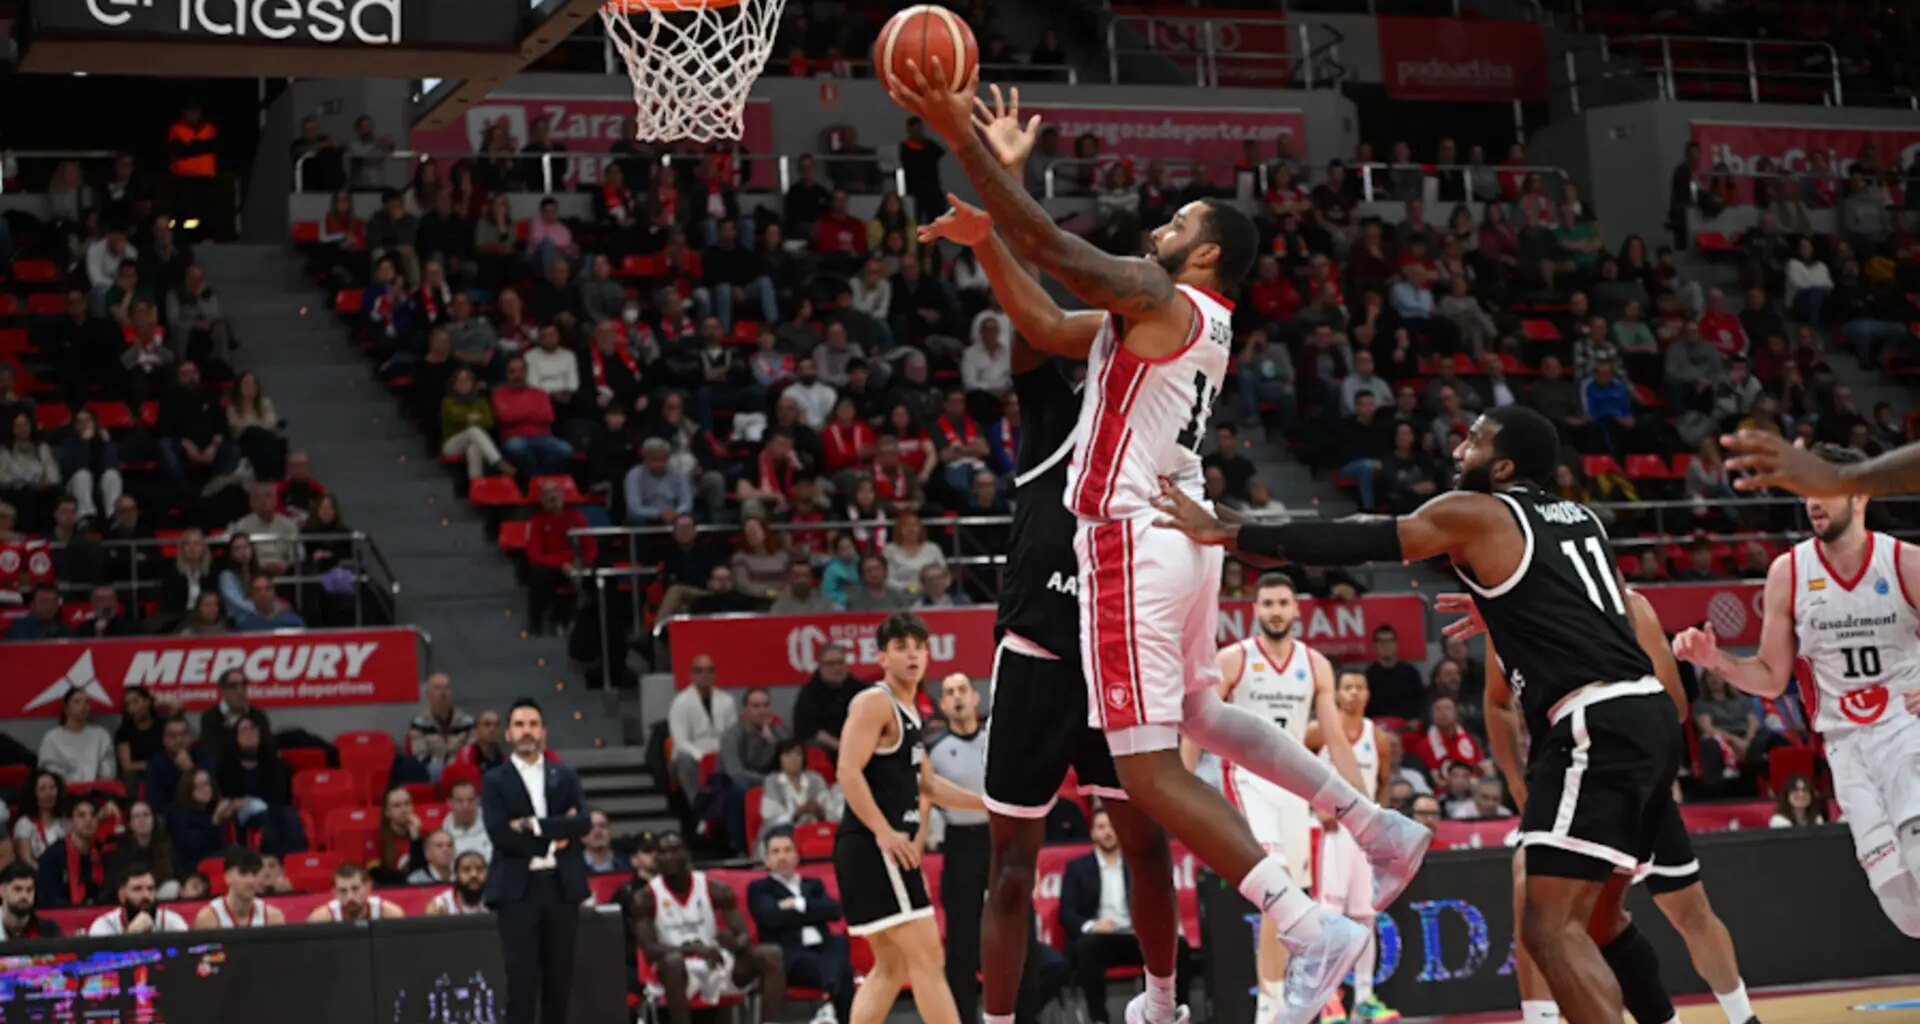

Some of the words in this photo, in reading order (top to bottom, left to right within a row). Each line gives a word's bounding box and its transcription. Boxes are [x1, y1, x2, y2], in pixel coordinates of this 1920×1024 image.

[542, 104, 624, 140] Zara
[1046, 570, 1080, 597] AA
[1560, 535, 1626, 616] 11
[122, 642, 380, 687] MERCURY
[1841, 646, 1882, 678] 10
